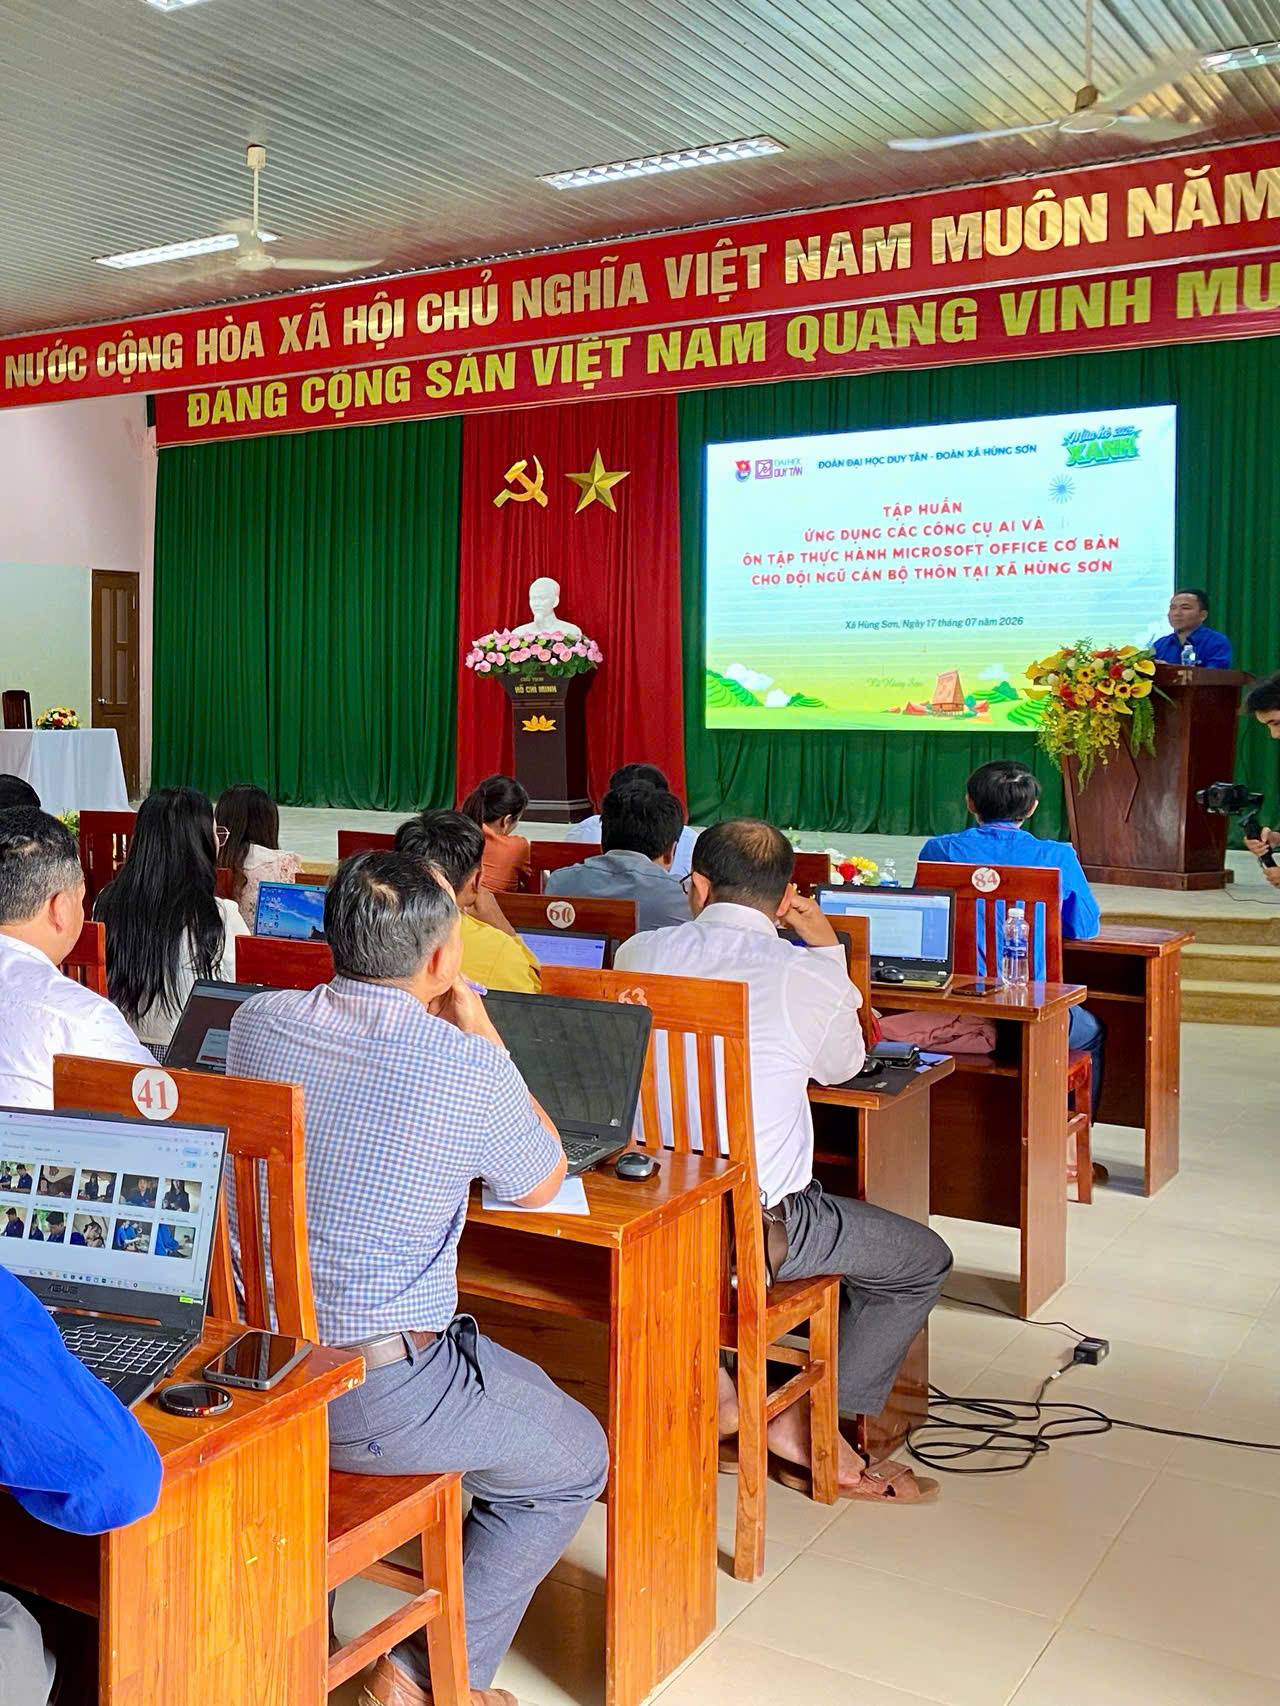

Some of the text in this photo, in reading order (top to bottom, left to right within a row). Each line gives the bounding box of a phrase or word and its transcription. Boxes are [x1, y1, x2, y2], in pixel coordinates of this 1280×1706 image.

[5, 164, 1280, 389] NƯỚC CỘNG HÒA XÃ HỘI CHỦ NGHĨA VIỆT NAM MUÔN NĂM
[532, 335, 631, 390] VIỆT
[647, 322, 766, 375] NAM
[786, 298, 978, 362] QUANG
[998, 276, 1151, 336] VINH
[818, 457, 845, 470] ĐOÀN
[847, 457, 863, 469] ĐẠI
[865, 456, 885, 468] HỌC
[888, 454, 907, 464] DUY
[909, 451, 928, 462] TÂN
[936, 449, 964, 460] ĐOÀN
[967, 448, 980, 457] XÃ
[984, 444, 1012, 456] HÙNG
[1015, 444, 1038, 454] SƠN
[1066, 434, 1138, 467] XANH
[883, 497, 962, 521] TẬP HUẤN
[804, 516, 1044, 544] ỨNG DỤNG CÁC CÔNG CỤ AI VÀ
[743, 534, 1120, 568] ÔN TẬP THỰC HÀNH MICROSOFT OFFICE CƠ BẢN
[752, 559, 1113, 588] CHO ĐỘI NGŨ CÁN BỘ THÔN TẠI XÃ HÙNG SƠN
[858, 620, 880, 631] Hùng
[902, 619, 925, 630] Ngày
[926, 619, 936, 628] 17
[937, 617, 963, 628] tháng
[965, 618, 977, 627] 07
[978, 617, 997, 626] năm
[999, 616, 1024, 626] 2026
[539, 685, 557, 693] MINH
[975, 871, 998, 887] 84
[137, 1079, 170, 1110] 41
